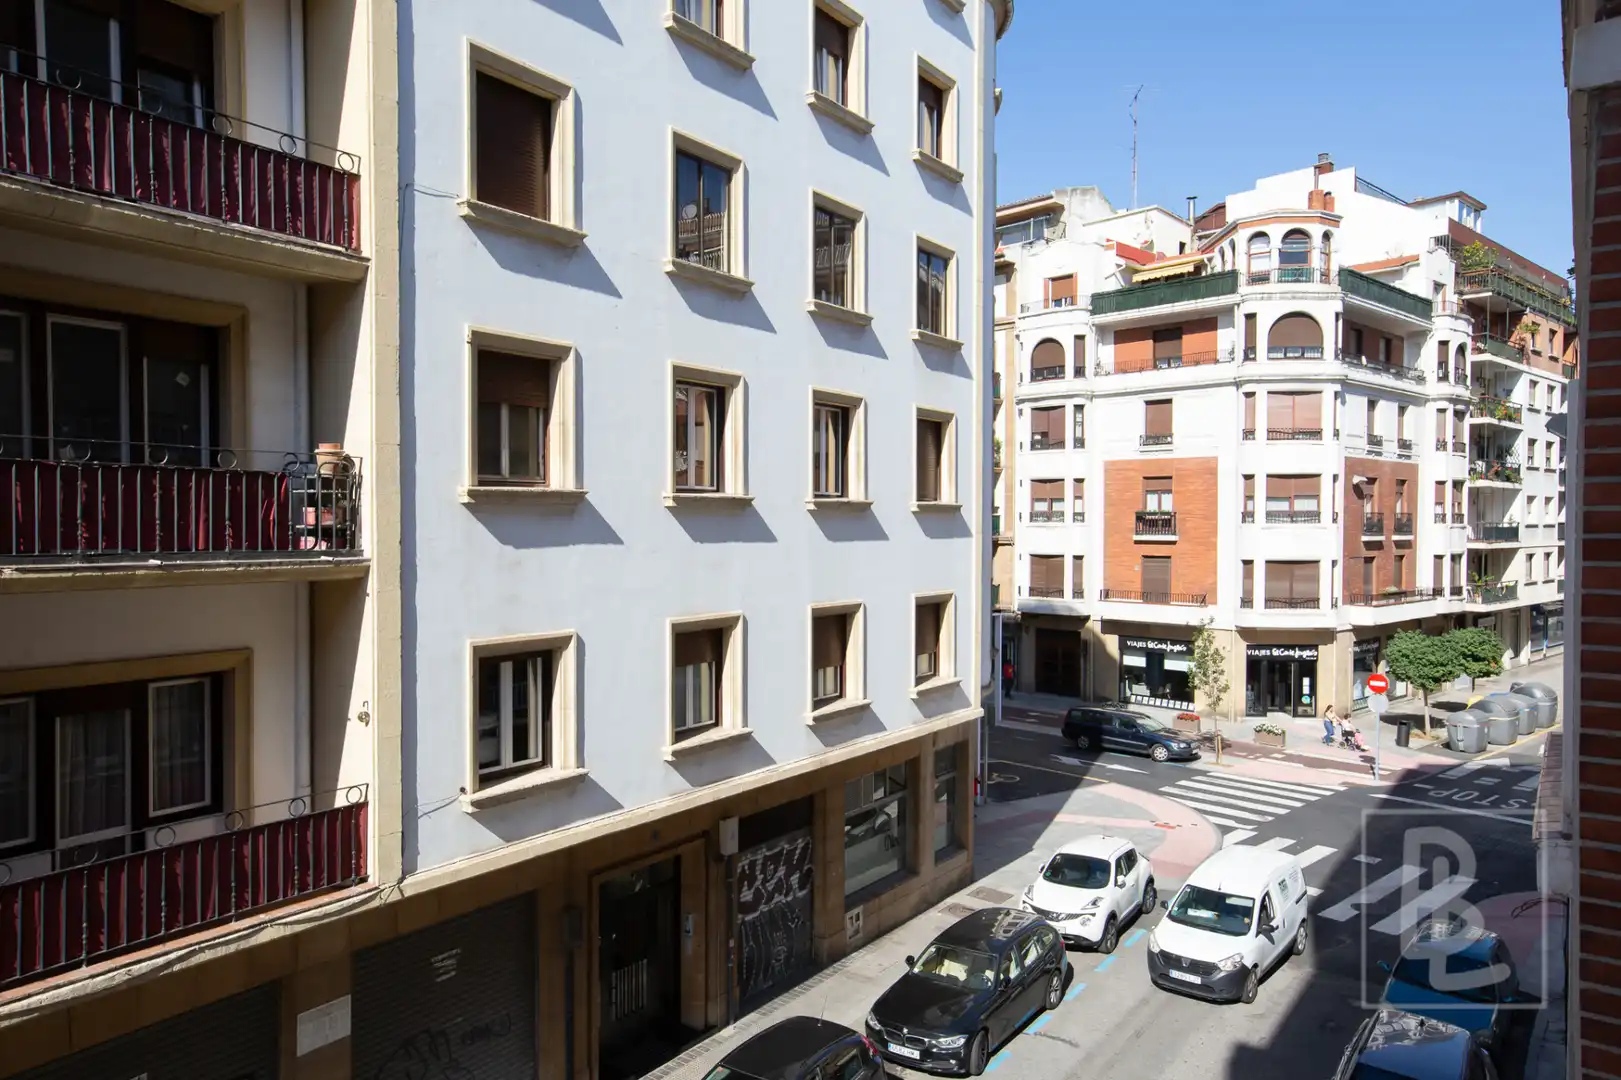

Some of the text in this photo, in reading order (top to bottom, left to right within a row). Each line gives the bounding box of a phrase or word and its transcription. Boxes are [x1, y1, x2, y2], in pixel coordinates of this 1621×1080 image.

[1126, 640, 1147, 648] VIAJES
[1246, 649, 1271, 657] VIAJES
[1427, 787, 1529, 810] STOP
